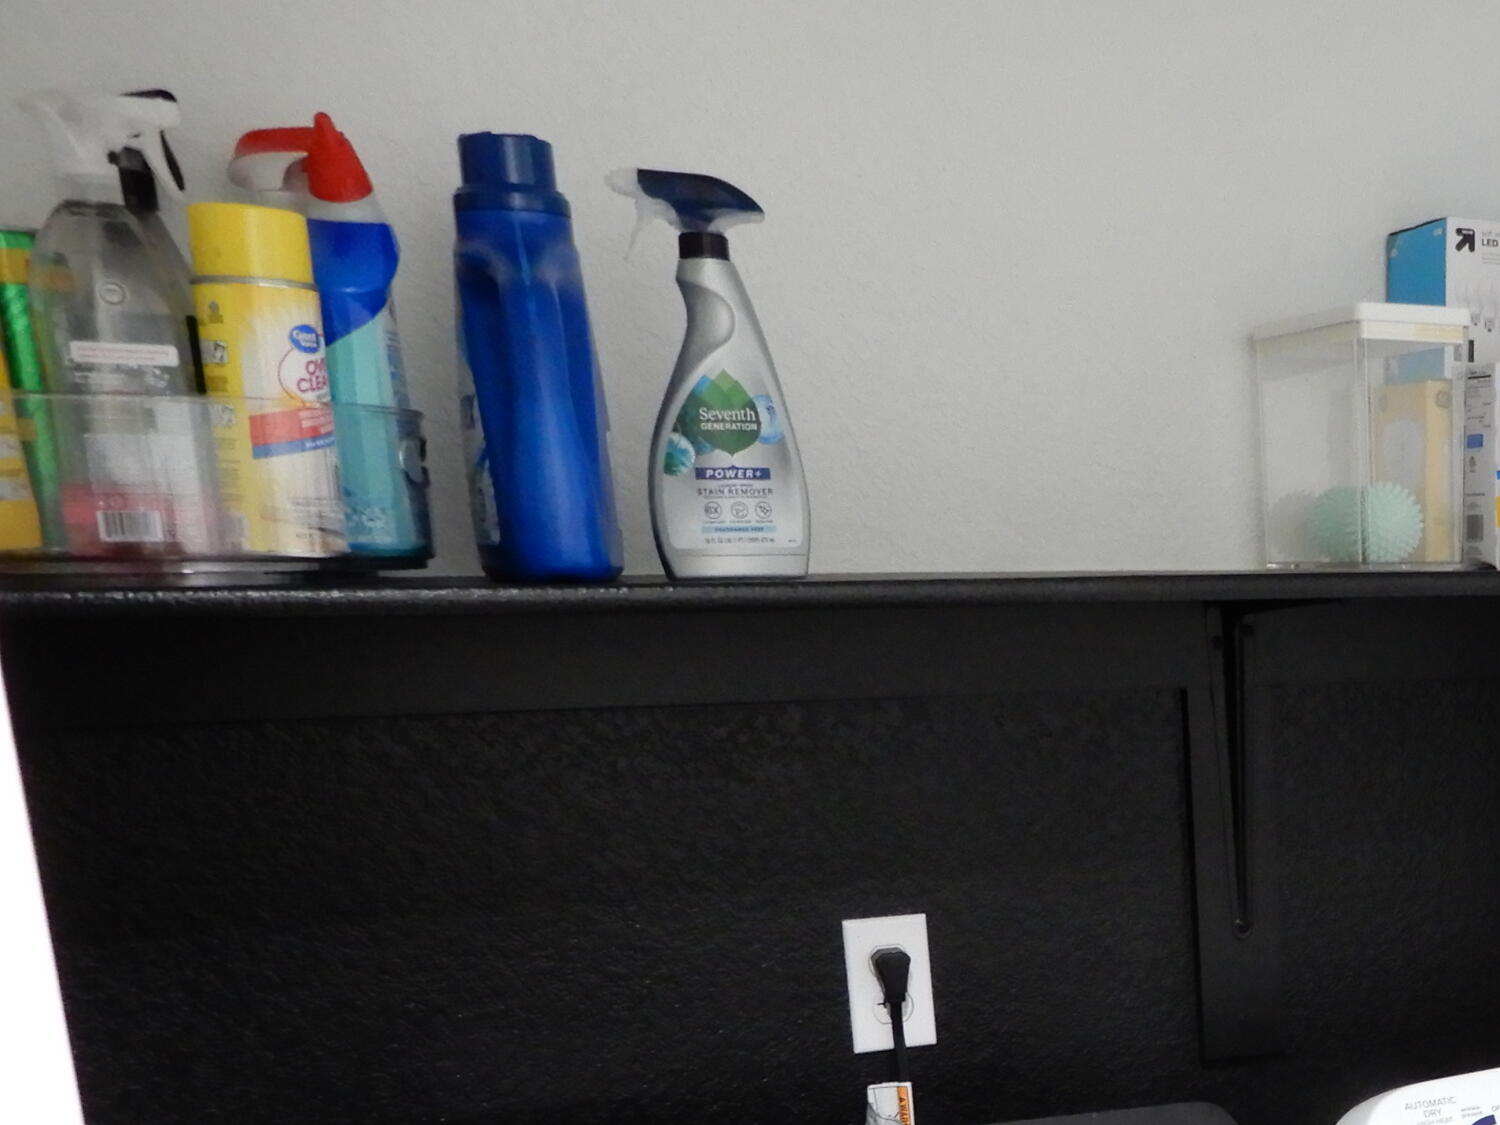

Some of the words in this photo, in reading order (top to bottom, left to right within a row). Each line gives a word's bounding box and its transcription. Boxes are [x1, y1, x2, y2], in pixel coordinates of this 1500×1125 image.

[1481, 238, 1499, 248] LED
[305, 357, 326, 375] OV
[296, 375, 328, 393] CLEA
[699, 406, 757, 422] Seventh
[700, 422, 758, 431] GENERATION
[705, 469, 763, 479] POWER+
[696, 487, 725, 496] STAIN
[728, 487, 774, 496] REMOVER
[1405, 1096, 1456, 1111] AUTOMATIC
[1423, 1109, 1442, 1118] DRY
